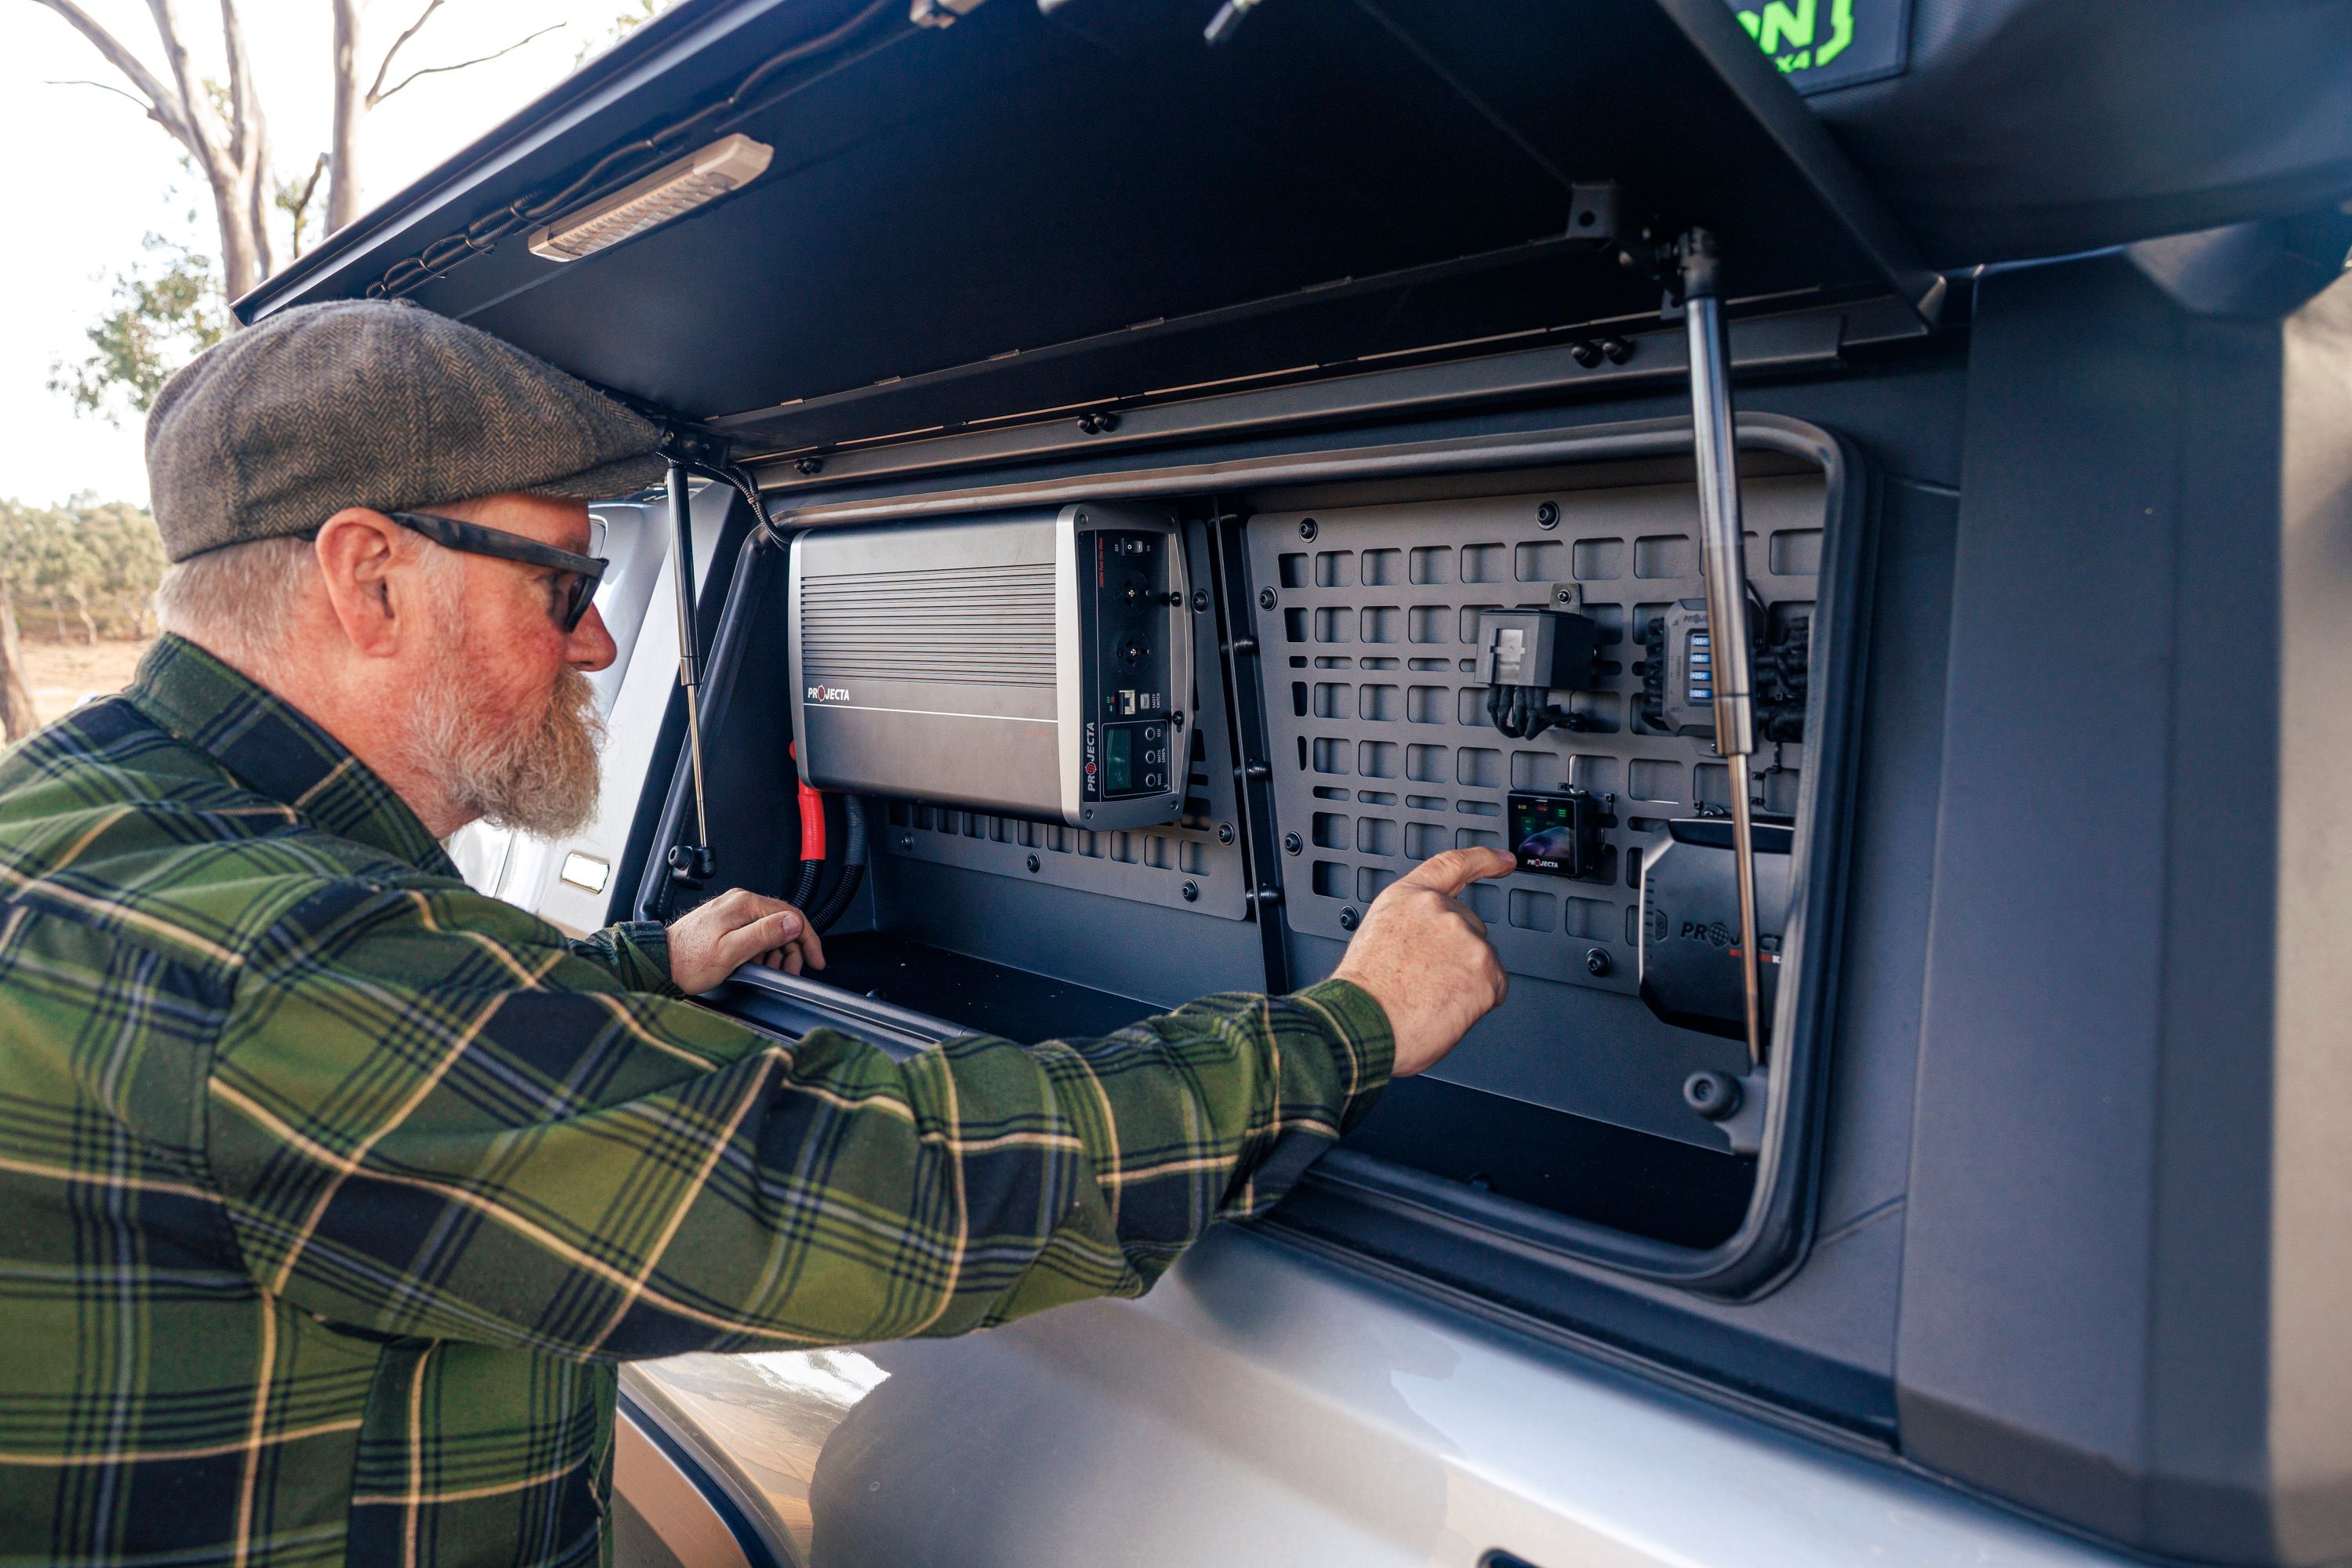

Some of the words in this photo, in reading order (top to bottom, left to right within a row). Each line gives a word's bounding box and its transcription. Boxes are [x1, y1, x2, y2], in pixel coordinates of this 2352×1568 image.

[808, 684, 850, 702] PROJECTA
[1086, 722, 1097, 792] PROJECTA
[1527, 859, 1559, 868] PROJECTA
